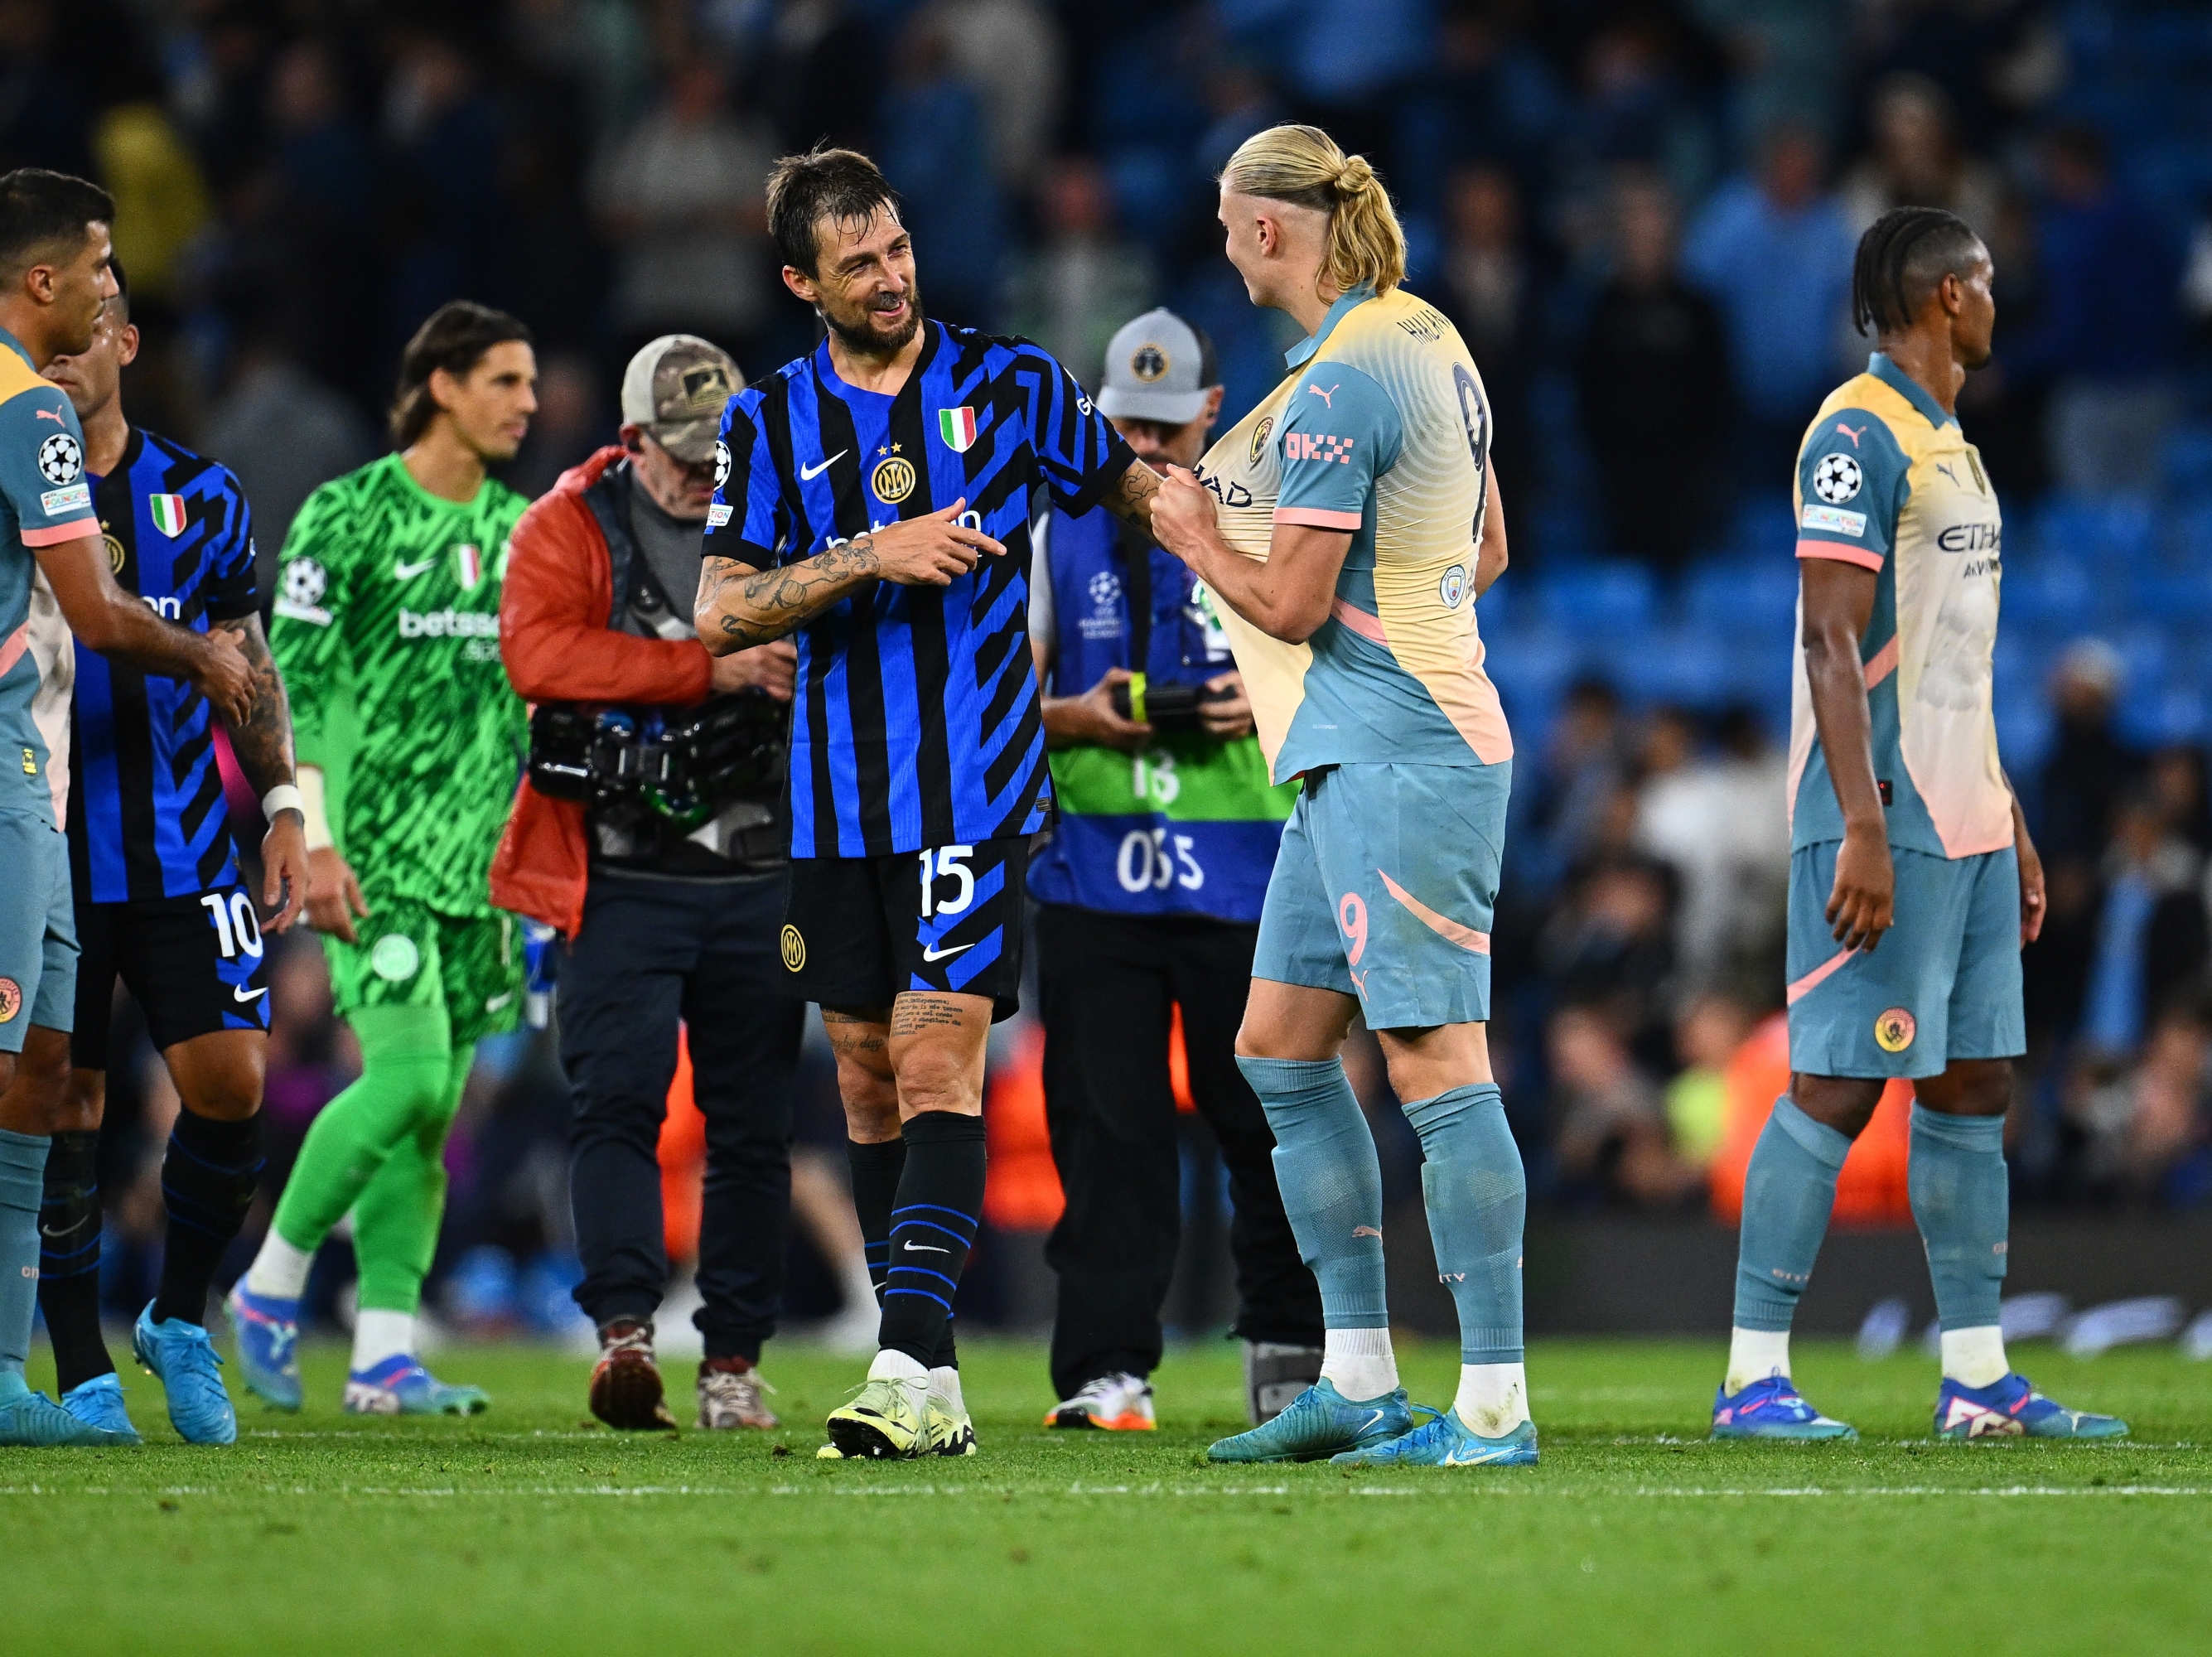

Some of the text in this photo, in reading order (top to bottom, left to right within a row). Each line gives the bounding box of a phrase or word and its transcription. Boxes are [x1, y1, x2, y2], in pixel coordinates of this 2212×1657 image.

[1396, 304, 1451, 345] HAALAN
[1285, 432, 1354, 464] OKX
[1452, 362, 1487, 543] 9
[919, 844, 974, 917] 15
[200, 891, 263, 959] 10
[1339, 891, 1368, 966] 9
